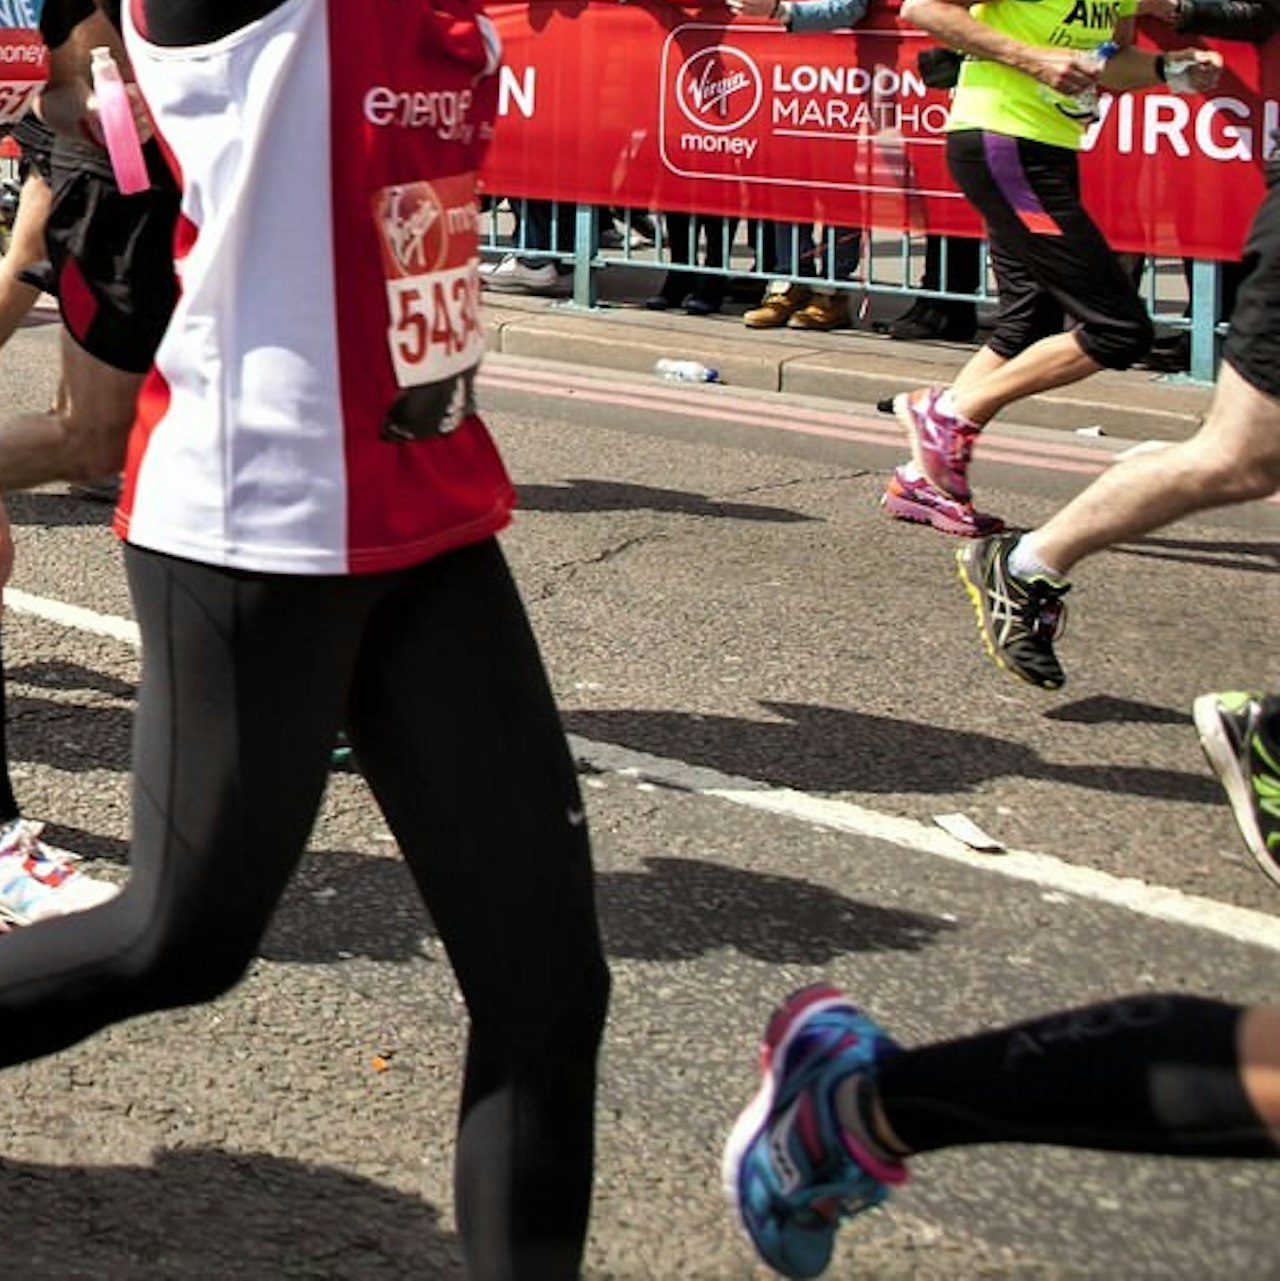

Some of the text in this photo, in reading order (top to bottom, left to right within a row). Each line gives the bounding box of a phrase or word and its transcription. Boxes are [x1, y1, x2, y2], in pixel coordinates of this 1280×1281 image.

[689, 59, 751, 117] Virgin
[772, 64, 927, 98] LONDON
[680, 133, 758, 160] money
